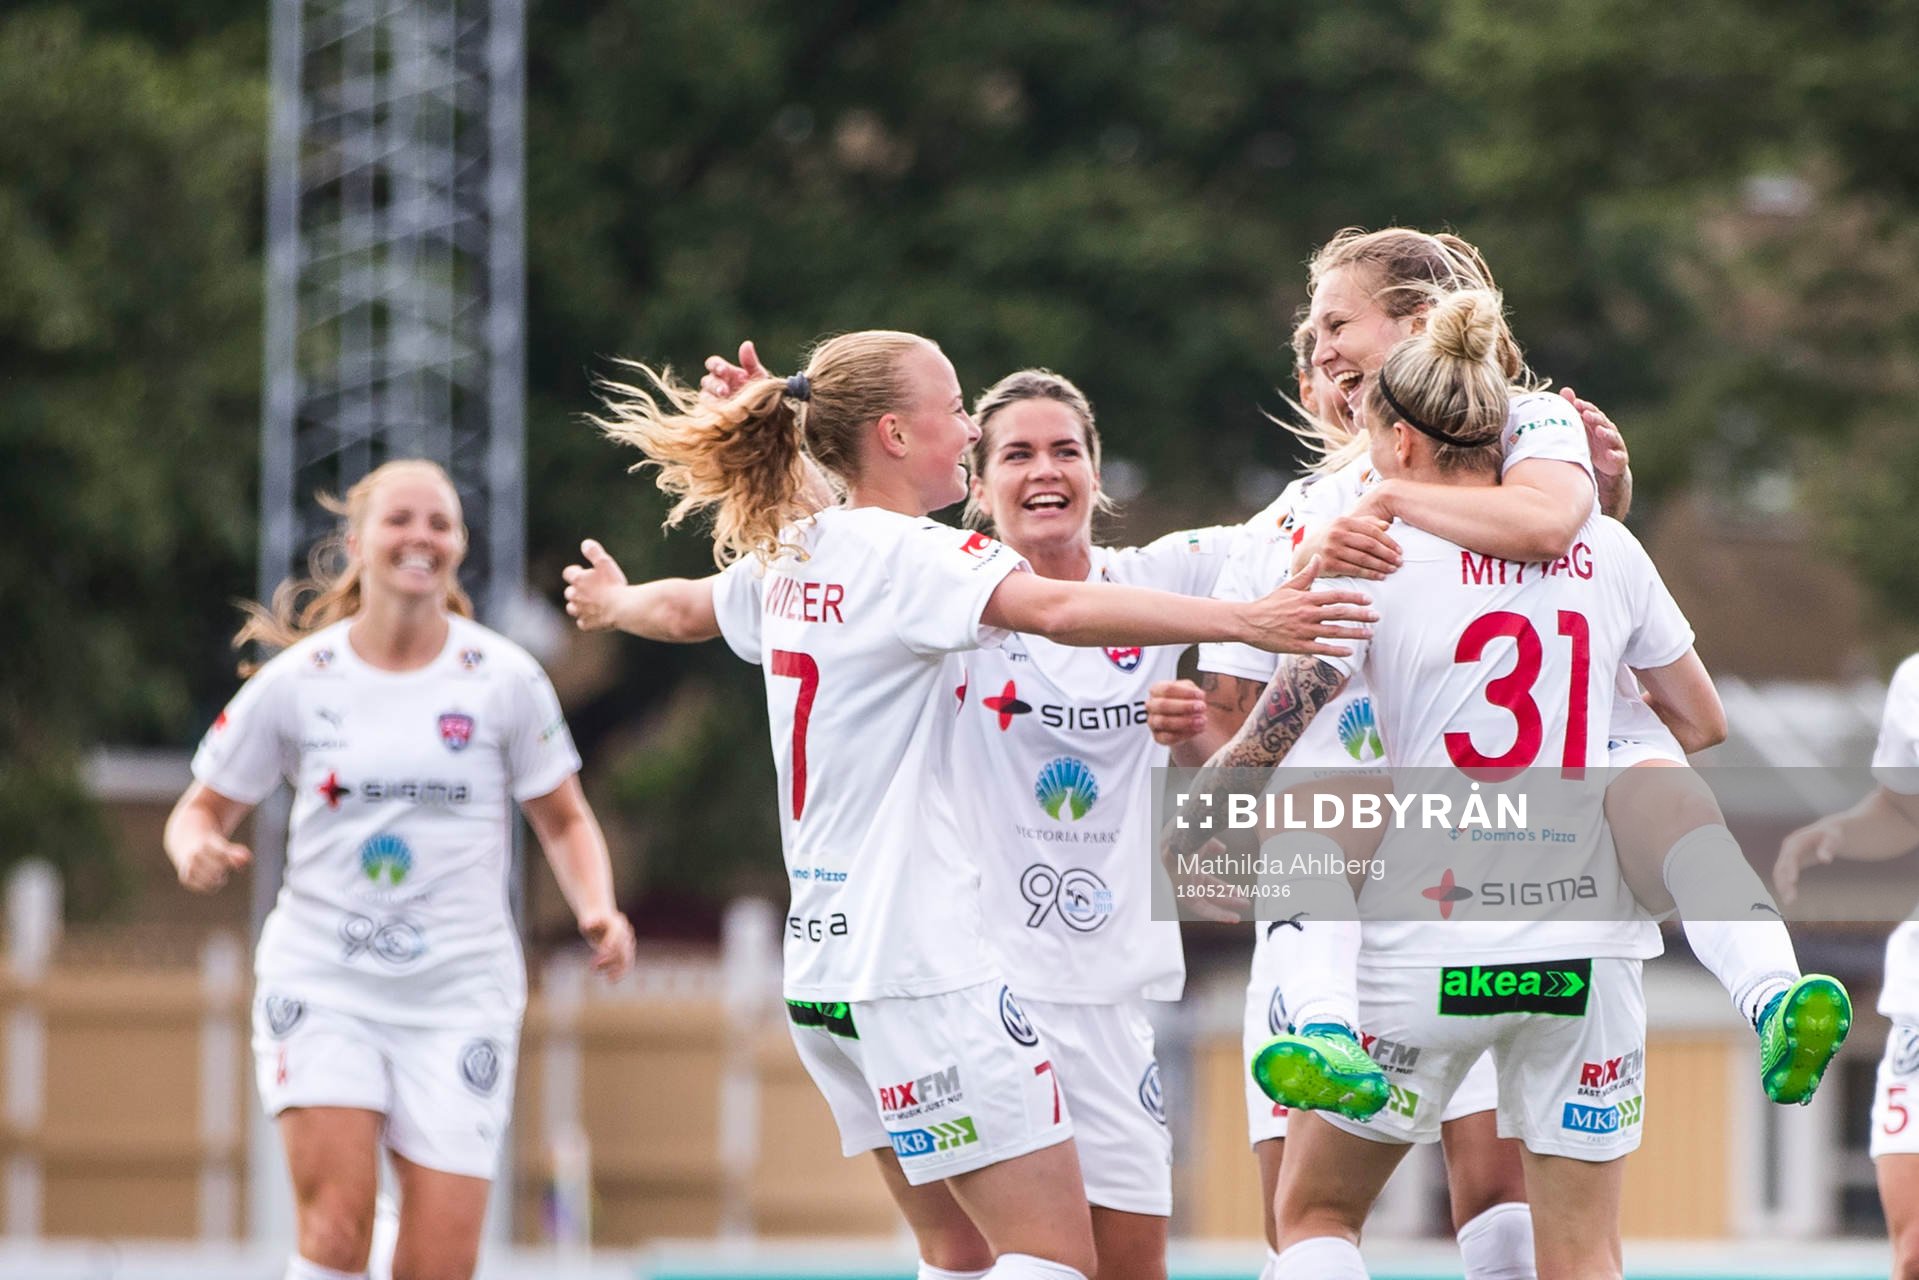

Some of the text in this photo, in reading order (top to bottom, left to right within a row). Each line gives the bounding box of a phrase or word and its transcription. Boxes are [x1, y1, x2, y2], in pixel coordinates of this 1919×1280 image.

[1443, 610, 1590, 783] 31
[771, 649, 820, 821] 7
[1016, 824, 1079, 842] VICTORIA
[1542, 829, 1577, 843] Pizza
[1444, 965, 1541, 997] akea
[1361, 1031, 1421, 1067] XFM
[879, 1065, 960, 1112] RIXFM
[1034, 1060, 1061, 1125] 7
[1570, 1107, 1617, 1130] MKB
[1883, 1087, 1909, 1135] 5
